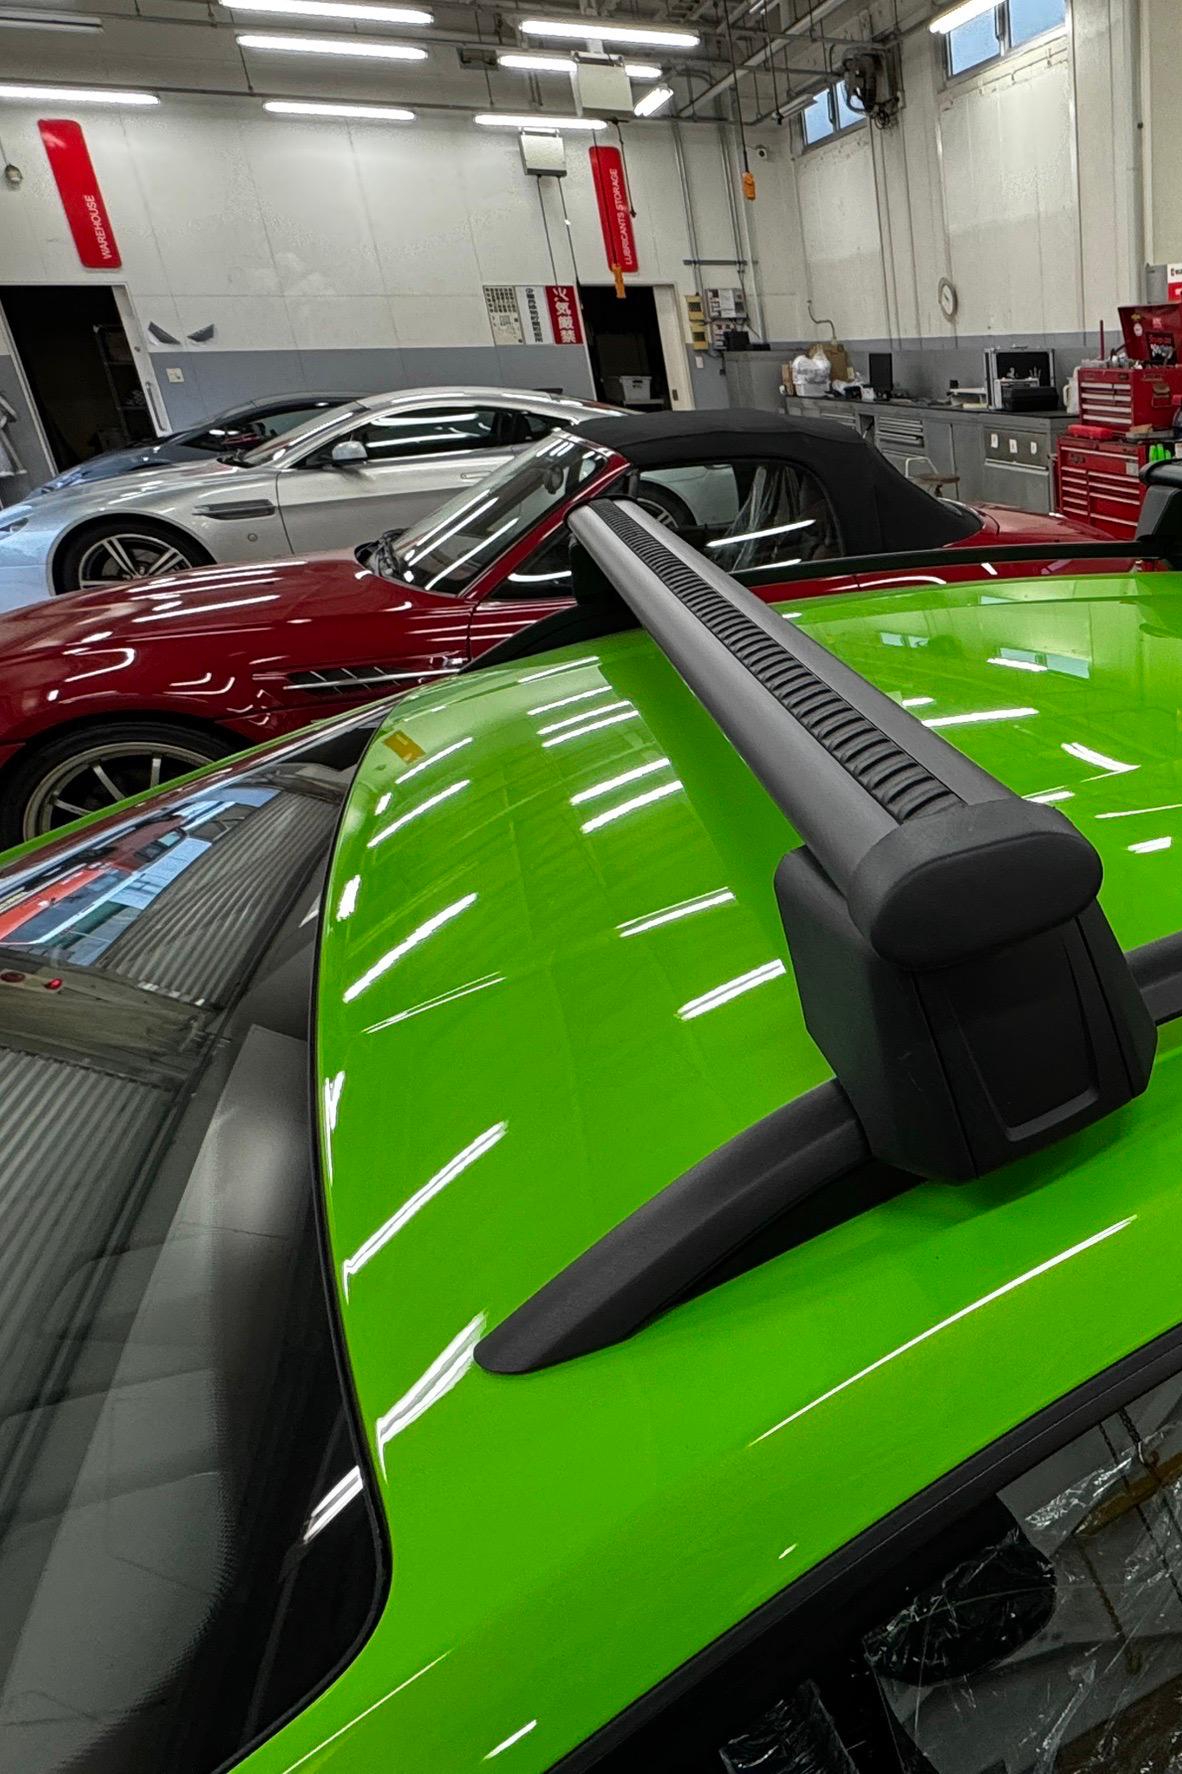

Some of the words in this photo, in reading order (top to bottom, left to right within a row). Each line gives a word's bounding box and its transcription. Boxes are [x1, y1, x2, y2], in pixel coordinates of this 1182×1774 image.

[610, 169, 624, 211] STORAGE
[84, 194, 112, 260] WAREHOUSE
[617, 213, 632, 265] LUBRICANTS
